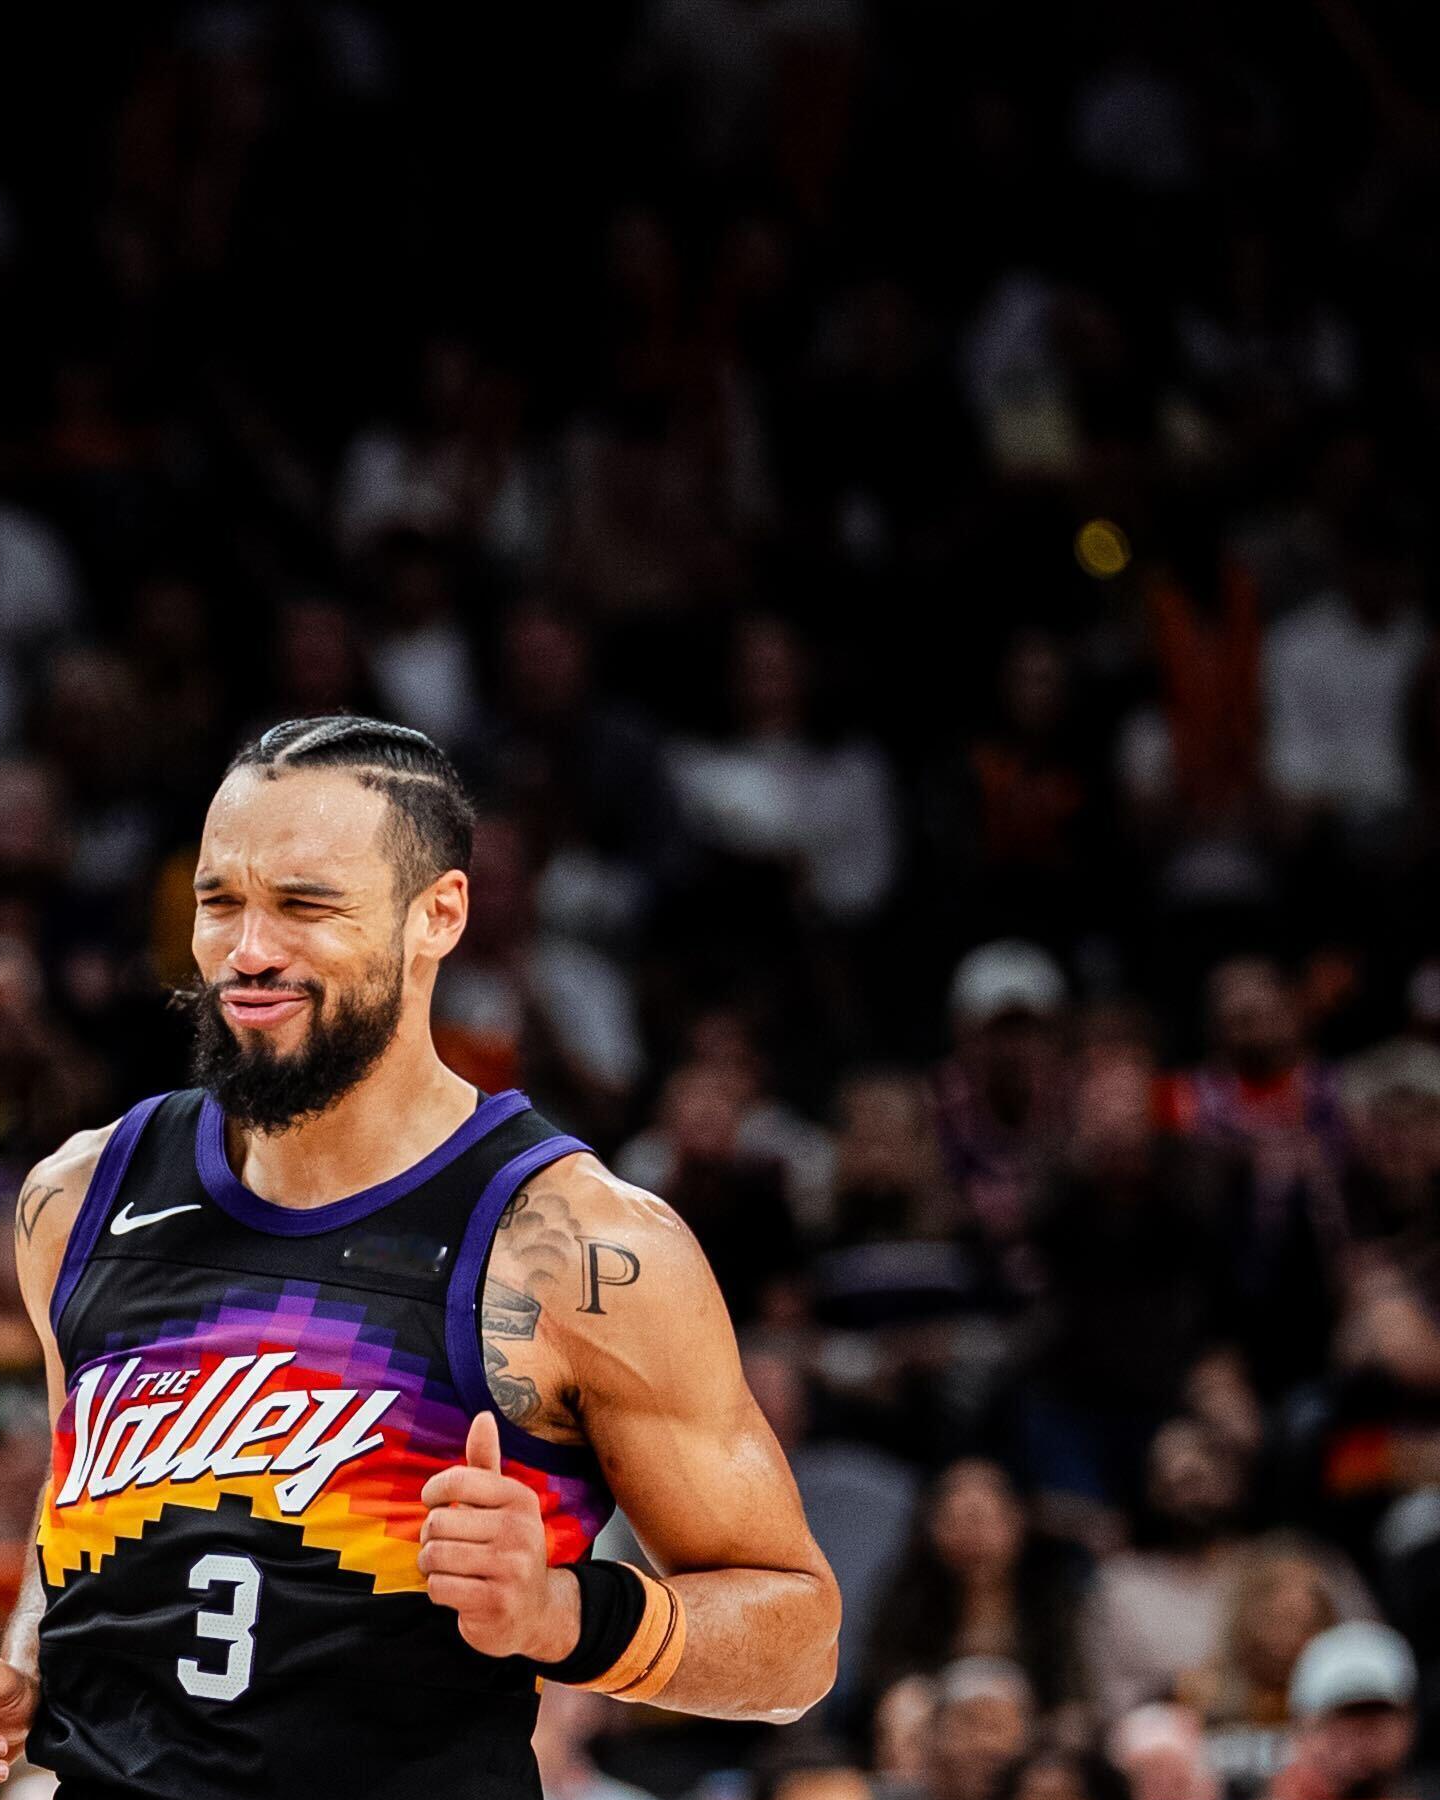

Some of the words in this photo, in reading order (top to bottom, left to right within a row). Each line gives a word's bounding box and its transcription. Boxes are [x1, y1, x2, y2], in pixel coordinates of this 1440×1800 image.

[574, 1235, 640, 1315] P
[55, 1350, 401, 1516] Valley
[131, 1368, 201, 1399] THE
[175, 1552, 264, 1703] 3
